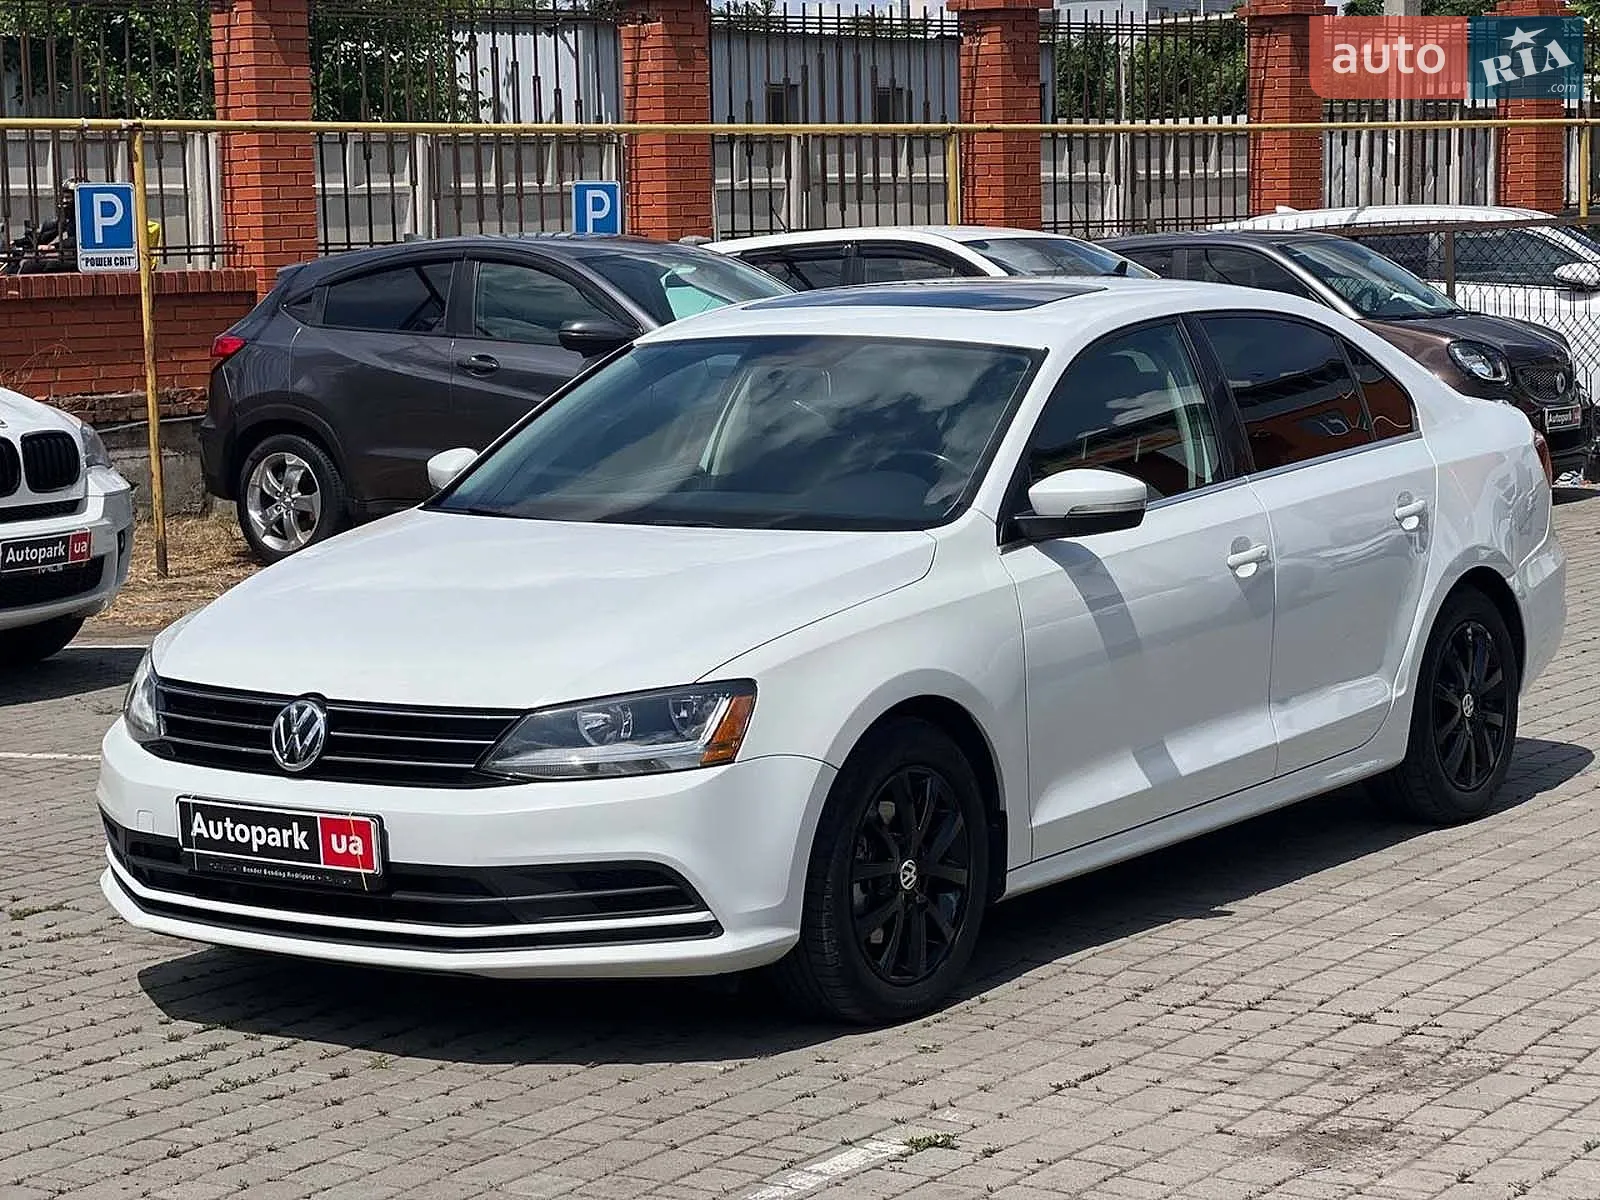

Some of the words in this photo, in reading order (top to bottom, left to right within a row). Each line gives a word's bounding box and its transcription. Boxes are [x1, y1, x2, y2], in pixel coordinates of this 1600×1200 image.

[92, 193, 124, 244] P
[586, 190, 611, 234] P
[5, 541, 66, 564] Autopark
[73, 540, 88, 554] ua
[191, 811, 310, 852] Autopark
[331, 832, 364, 856] ua
